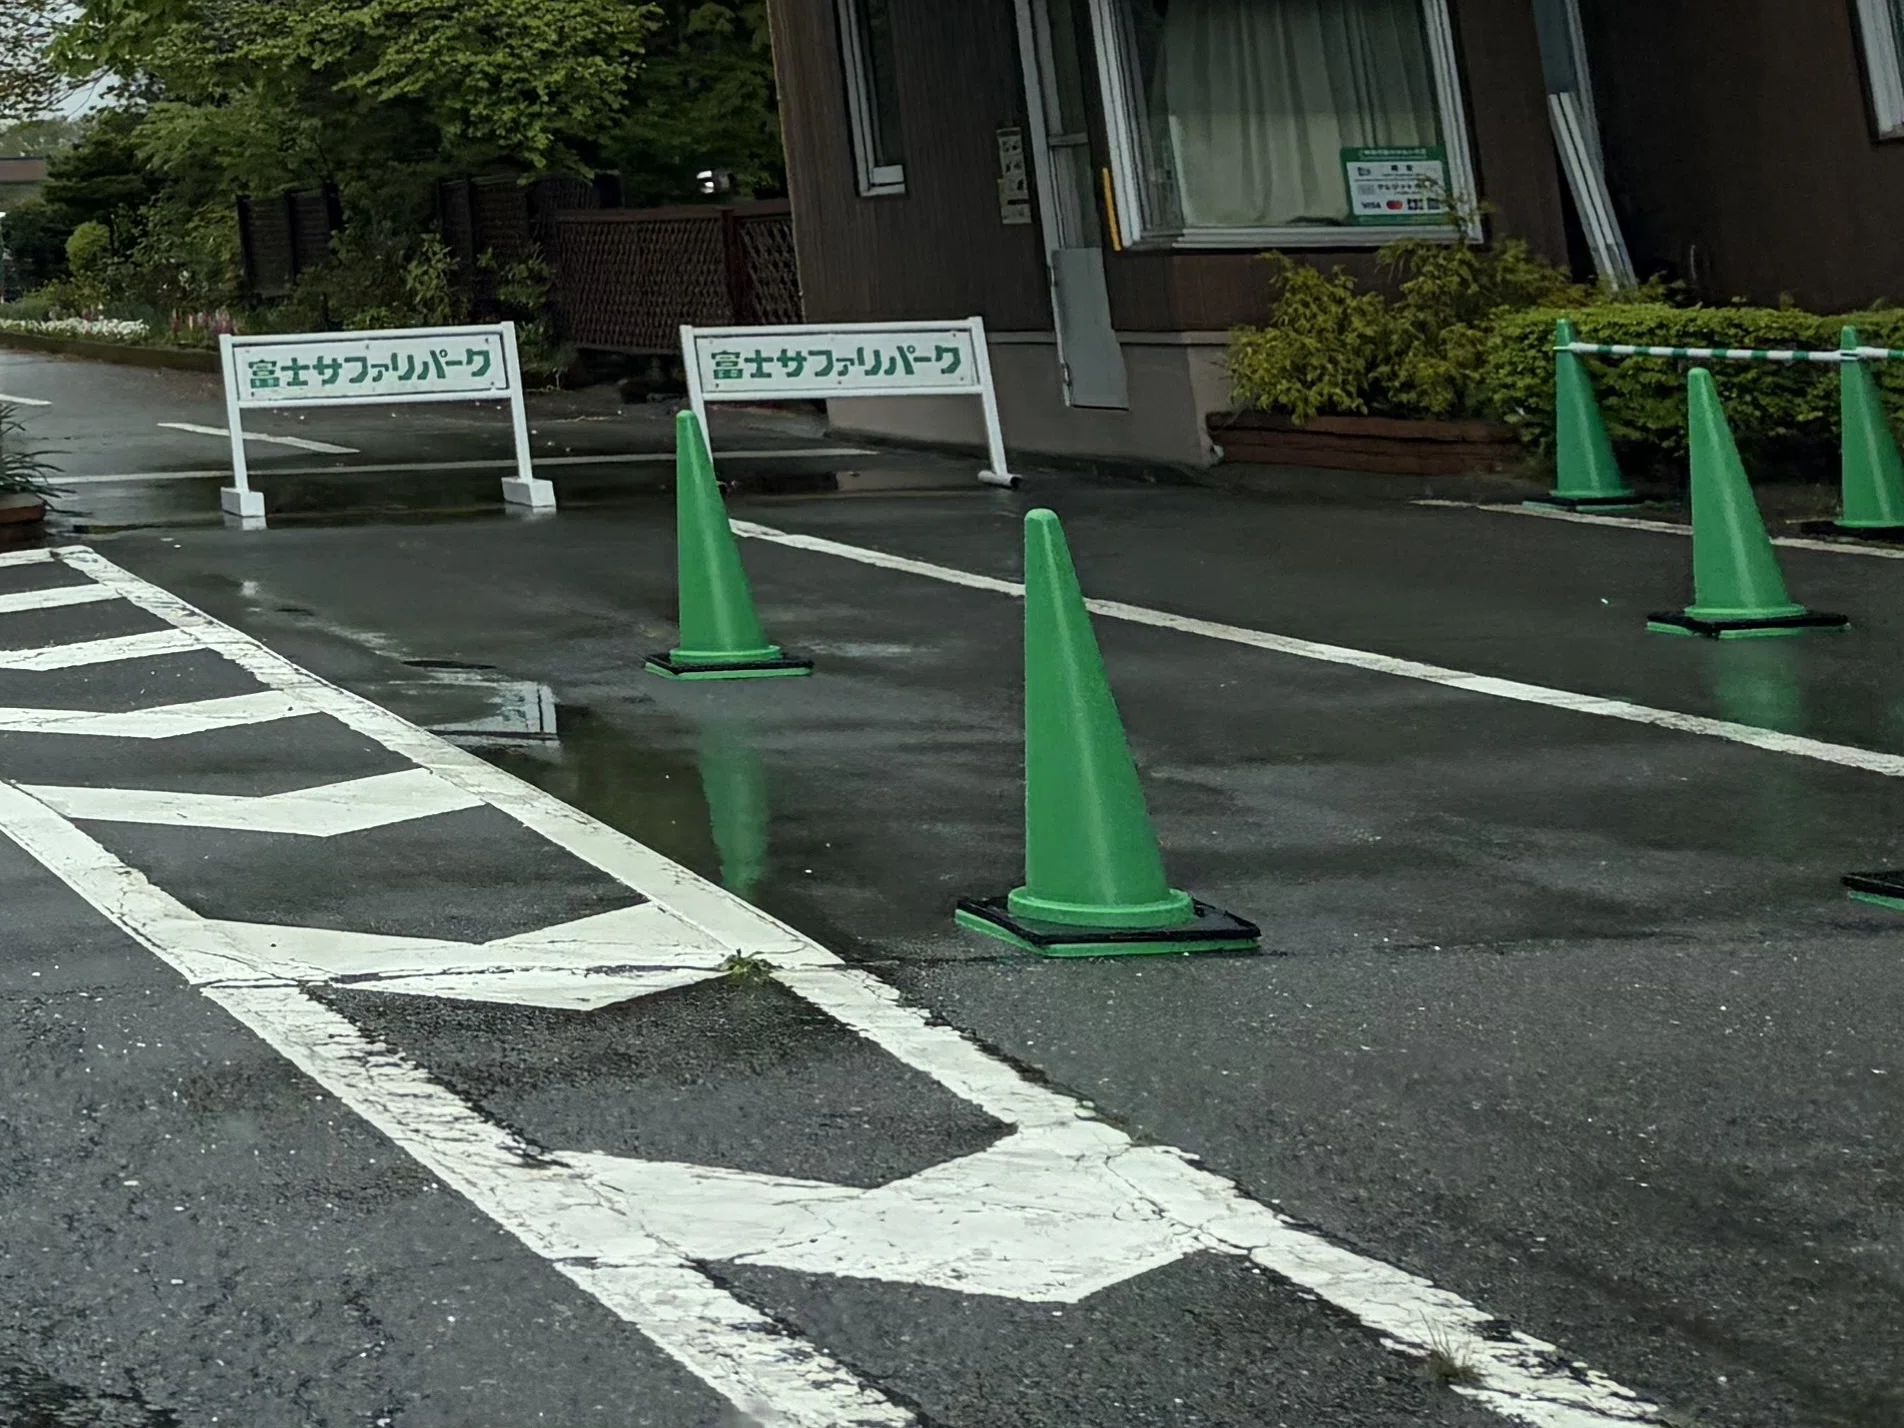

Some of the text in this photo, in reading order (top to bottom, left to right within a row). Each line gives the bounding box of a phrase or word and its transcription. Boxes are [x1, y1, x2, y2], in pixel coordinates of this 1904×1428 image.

[248, 348, 492, 389] 富士サファリパーク
[710, 344, 962, 380] 富士サファリパーク
